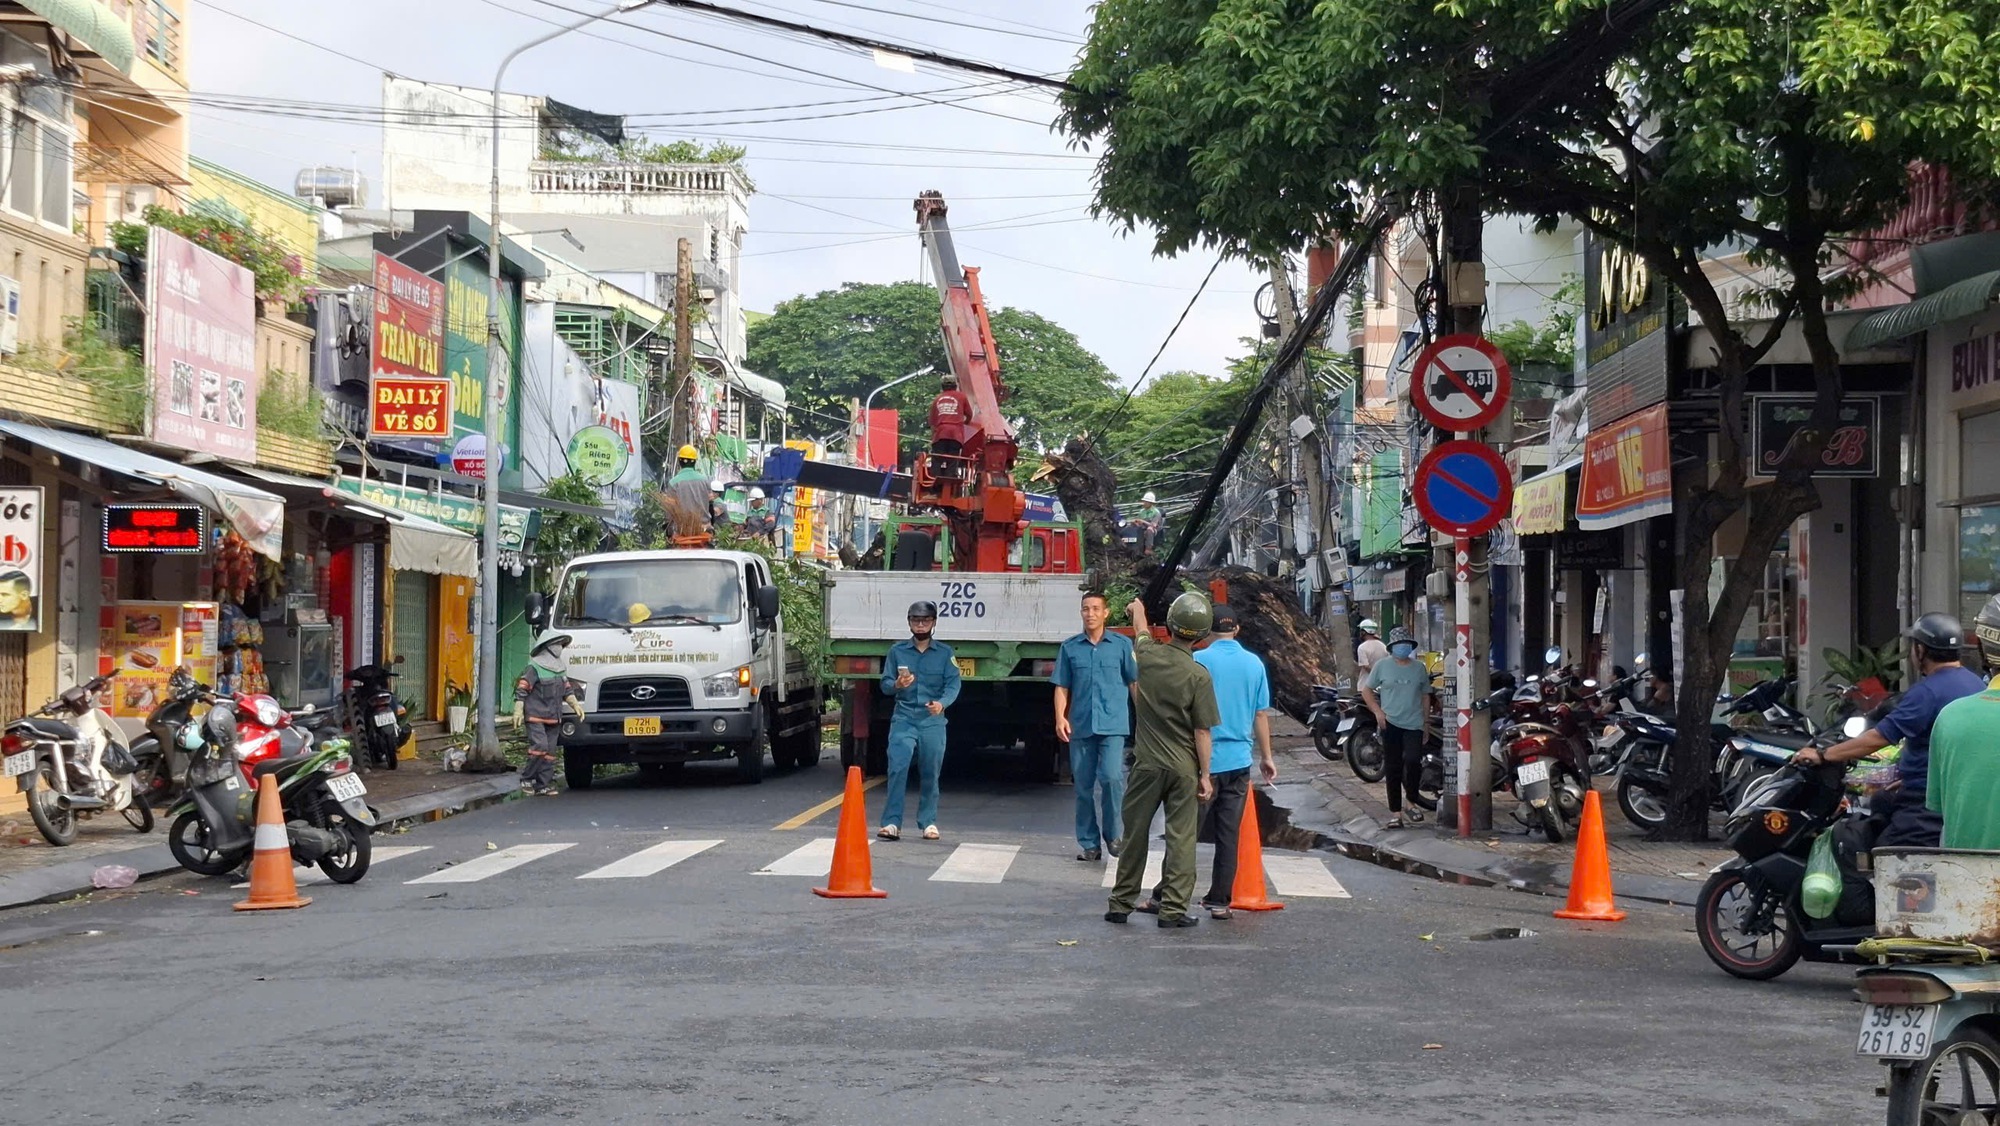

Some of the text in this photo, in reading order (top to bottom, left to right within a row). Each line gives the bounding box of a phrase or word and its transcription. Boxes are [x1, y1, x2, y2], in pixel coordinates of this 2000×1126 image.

[392, 274, 404, 297] ĐẠI
[420, 284, 430, 309] SỐ
[380, 310, 439, 376] THẦN TÀI
[1466, 371, 1492, 388] 3,5T
[379, 385, 443, 408] ĐẠI LÝ
[383, 408, 438, 431] VÉ SỐ
[399, 496, 455, 520] RIÊNG
[941, 582, 977, 599] 72C
[650, 639, 673, 648] UPC
[569, 654, 581, 665] CÔNG
[582, 656, 588, 664] TY
[596, 653, 608, 664] PHÁT
[660, 654, 674, 663] XANH
[628, 726, 657, 735] 019.09
[634, 718, 650, 726] 72H
[1871, 1005, 1926, 1029] 59-S2
[1859, 1031, 1926, 1055] 261.89
